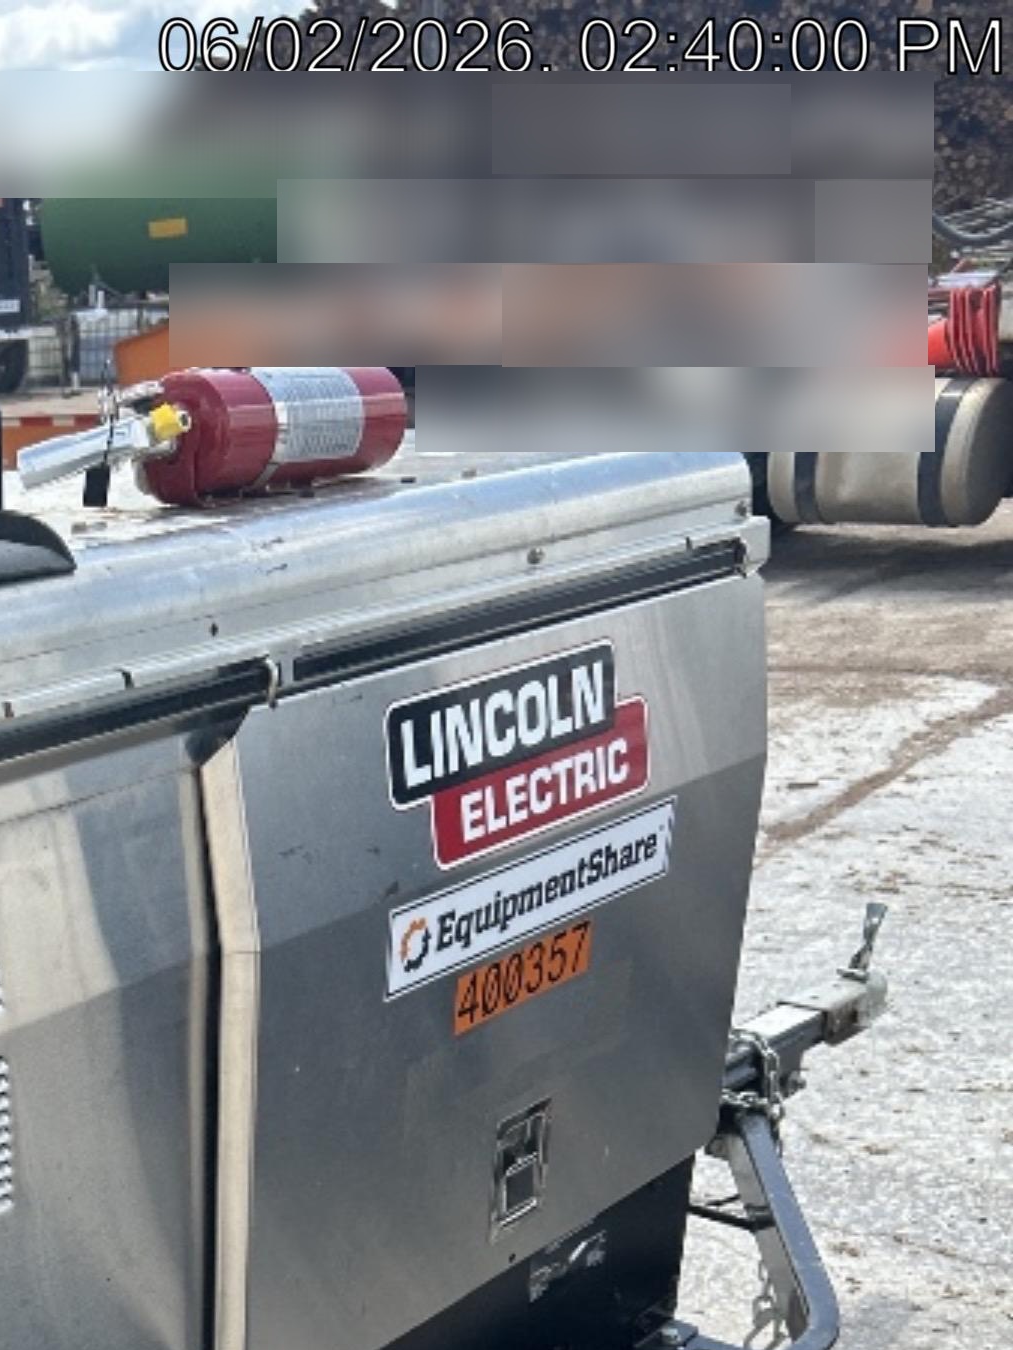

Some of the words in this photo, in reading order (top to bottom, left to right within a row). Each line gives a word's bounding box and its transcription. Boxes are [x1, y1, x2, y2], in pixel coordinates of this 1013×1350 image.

[400, 660, 606, 788] LINCOLN
[459, 737, 631, 844] ELECTRIC
[435, 832, 658, 951] EquipmentShare
[457, 919, 592, 1024] 400357
